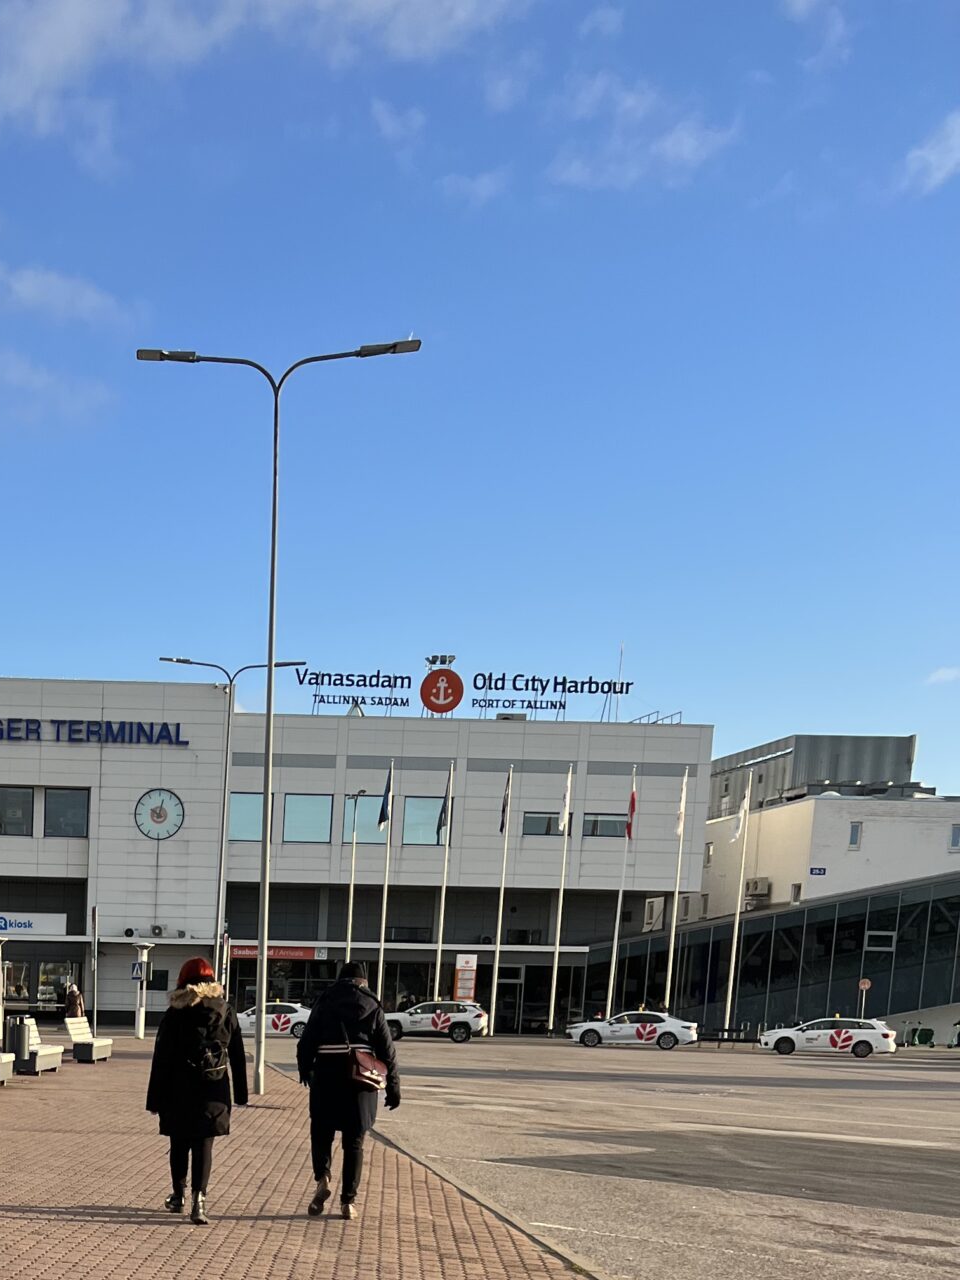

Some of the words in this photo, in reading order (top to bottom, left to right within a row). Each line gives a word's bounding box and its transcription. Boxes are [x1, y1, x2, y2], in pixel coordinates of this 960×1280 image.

[295, 667, 411, 689] Vanasadam
[473, 672, 506, 691] Old
[512, 673, 550, 696] City
[553, 676, 634, 695] Harbour
[312, 694, 367, 705] TALLINNA
[370, 696, 410, 707] SADAM
[472, 698, 498, 708] PORT
[498, 699, 517, 709] OF
[520, 699, 566, 710] TALLINN
[50, 719, 190, 746] TERMINAL
[8, 921, 33, 930] kiosk
